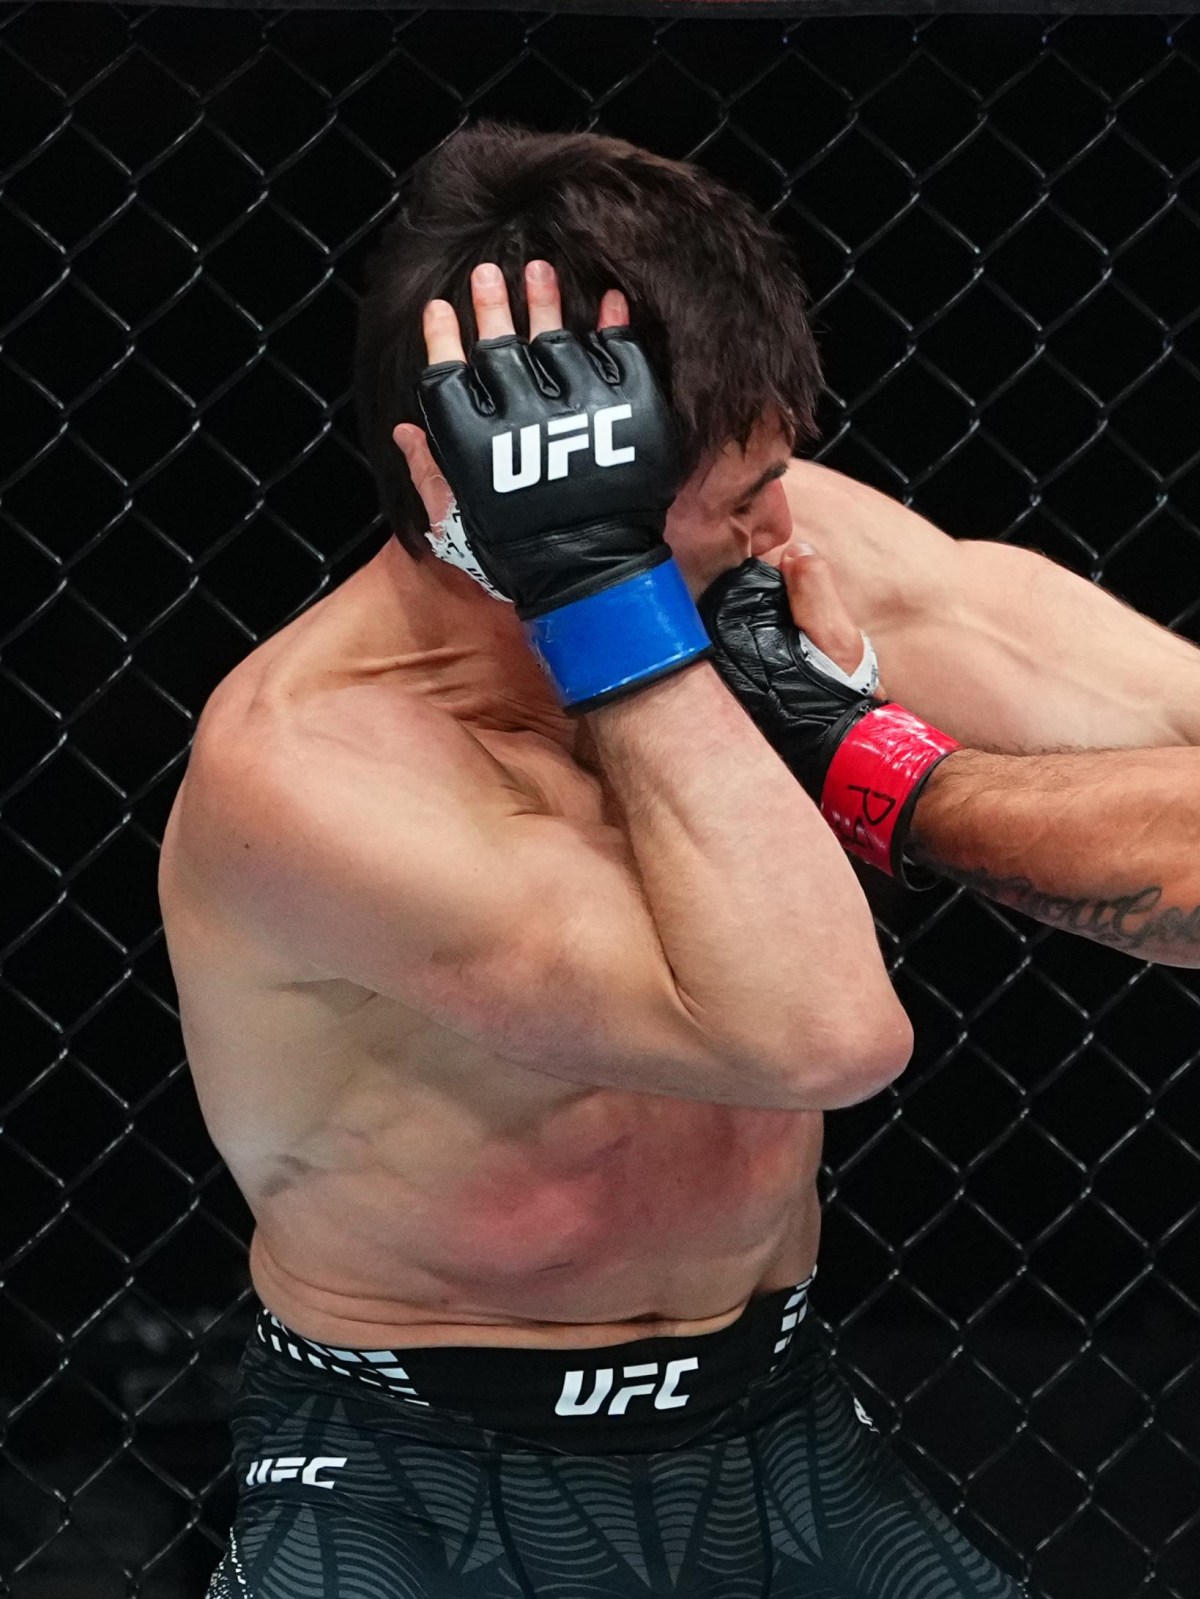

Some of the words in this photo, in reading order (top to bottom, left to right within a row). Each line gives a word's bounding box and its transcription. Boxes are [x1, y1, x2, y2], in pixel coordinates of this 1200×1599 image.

[490, 402, 636, 494] UFC
[554, 1357, 699, 1416] UFC
[245, 1456, 348, 1490] UFC
